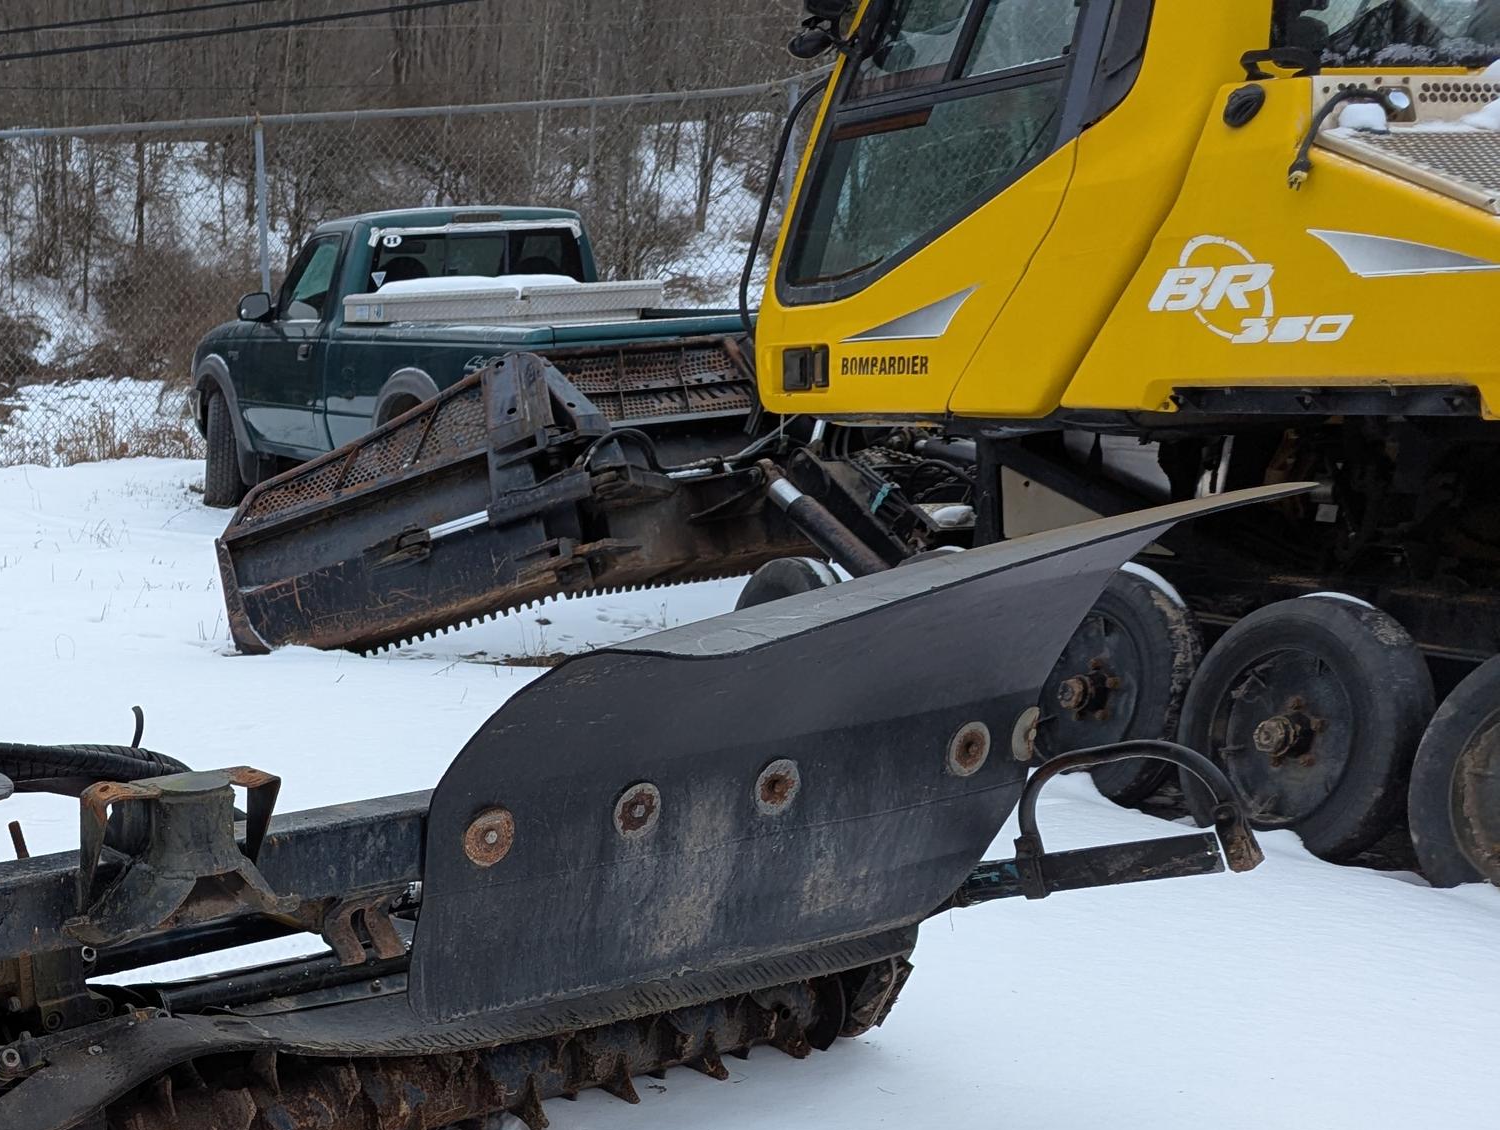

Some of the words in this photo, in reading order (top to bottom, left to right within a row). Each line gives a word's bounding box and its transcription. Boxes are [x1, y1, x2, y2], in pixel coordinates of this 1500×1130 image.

[1147, 263, 1275, 312] BR
[1231, 314, 1354, 344] 350
[841, 355, 929, 376] BOMBARDIER
